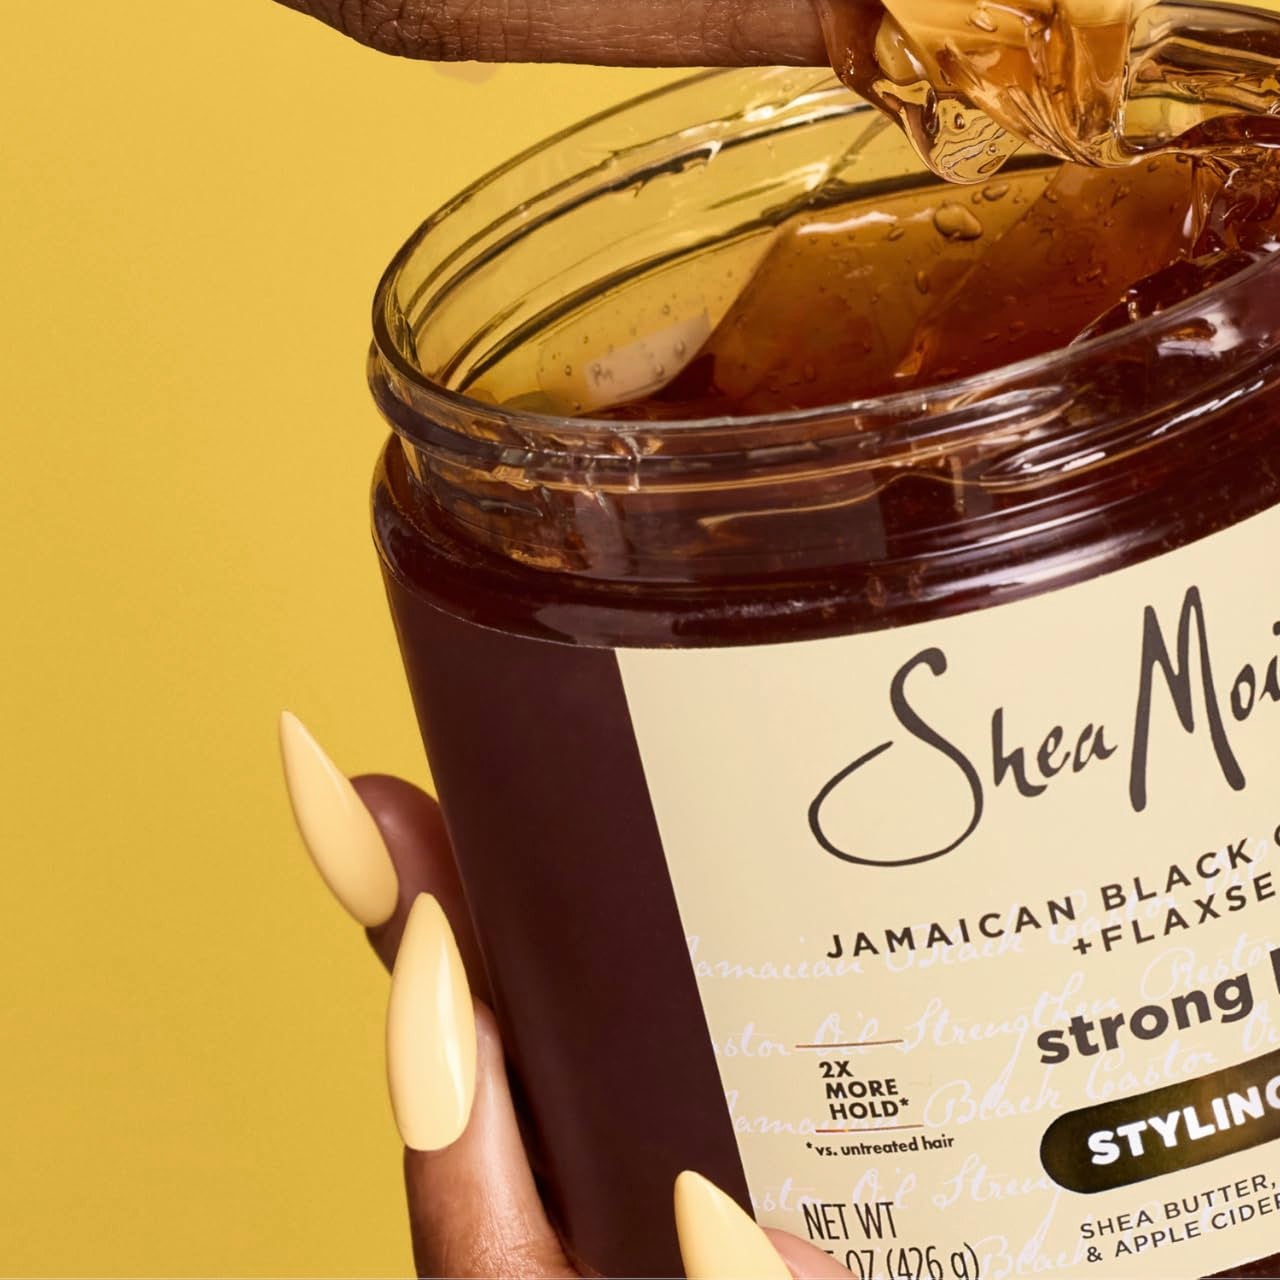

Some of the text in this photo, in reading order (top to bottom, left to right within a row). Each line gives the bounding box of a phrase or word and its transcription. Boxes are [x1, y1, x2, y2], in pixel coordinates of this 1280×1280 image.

[807, 647, 1118, 868] Shea
[826, 896, 1076, 959] JAMAICAN
[1100, 838, 1253, 912] BLACK
[1037, 972, 1254, 1065] strong
[818, 1060, 854, 1079] 2X
[825, 1078, 899, 1100] MORE
[840, 1136, 919, 1156] untreated
[920, 1134, 955, 1152] hair
[801, 1201, 897, 1240] NET WT
[1080, 1210, 1154, 1240] SHEA
[1163, 1174, 1277, 1220] BUTTER,
[1086, 1246, 1103, 1263] &
[1115, 1220, 1201, 1258] APPLE
[886, 1245, 944, 1280] (426
